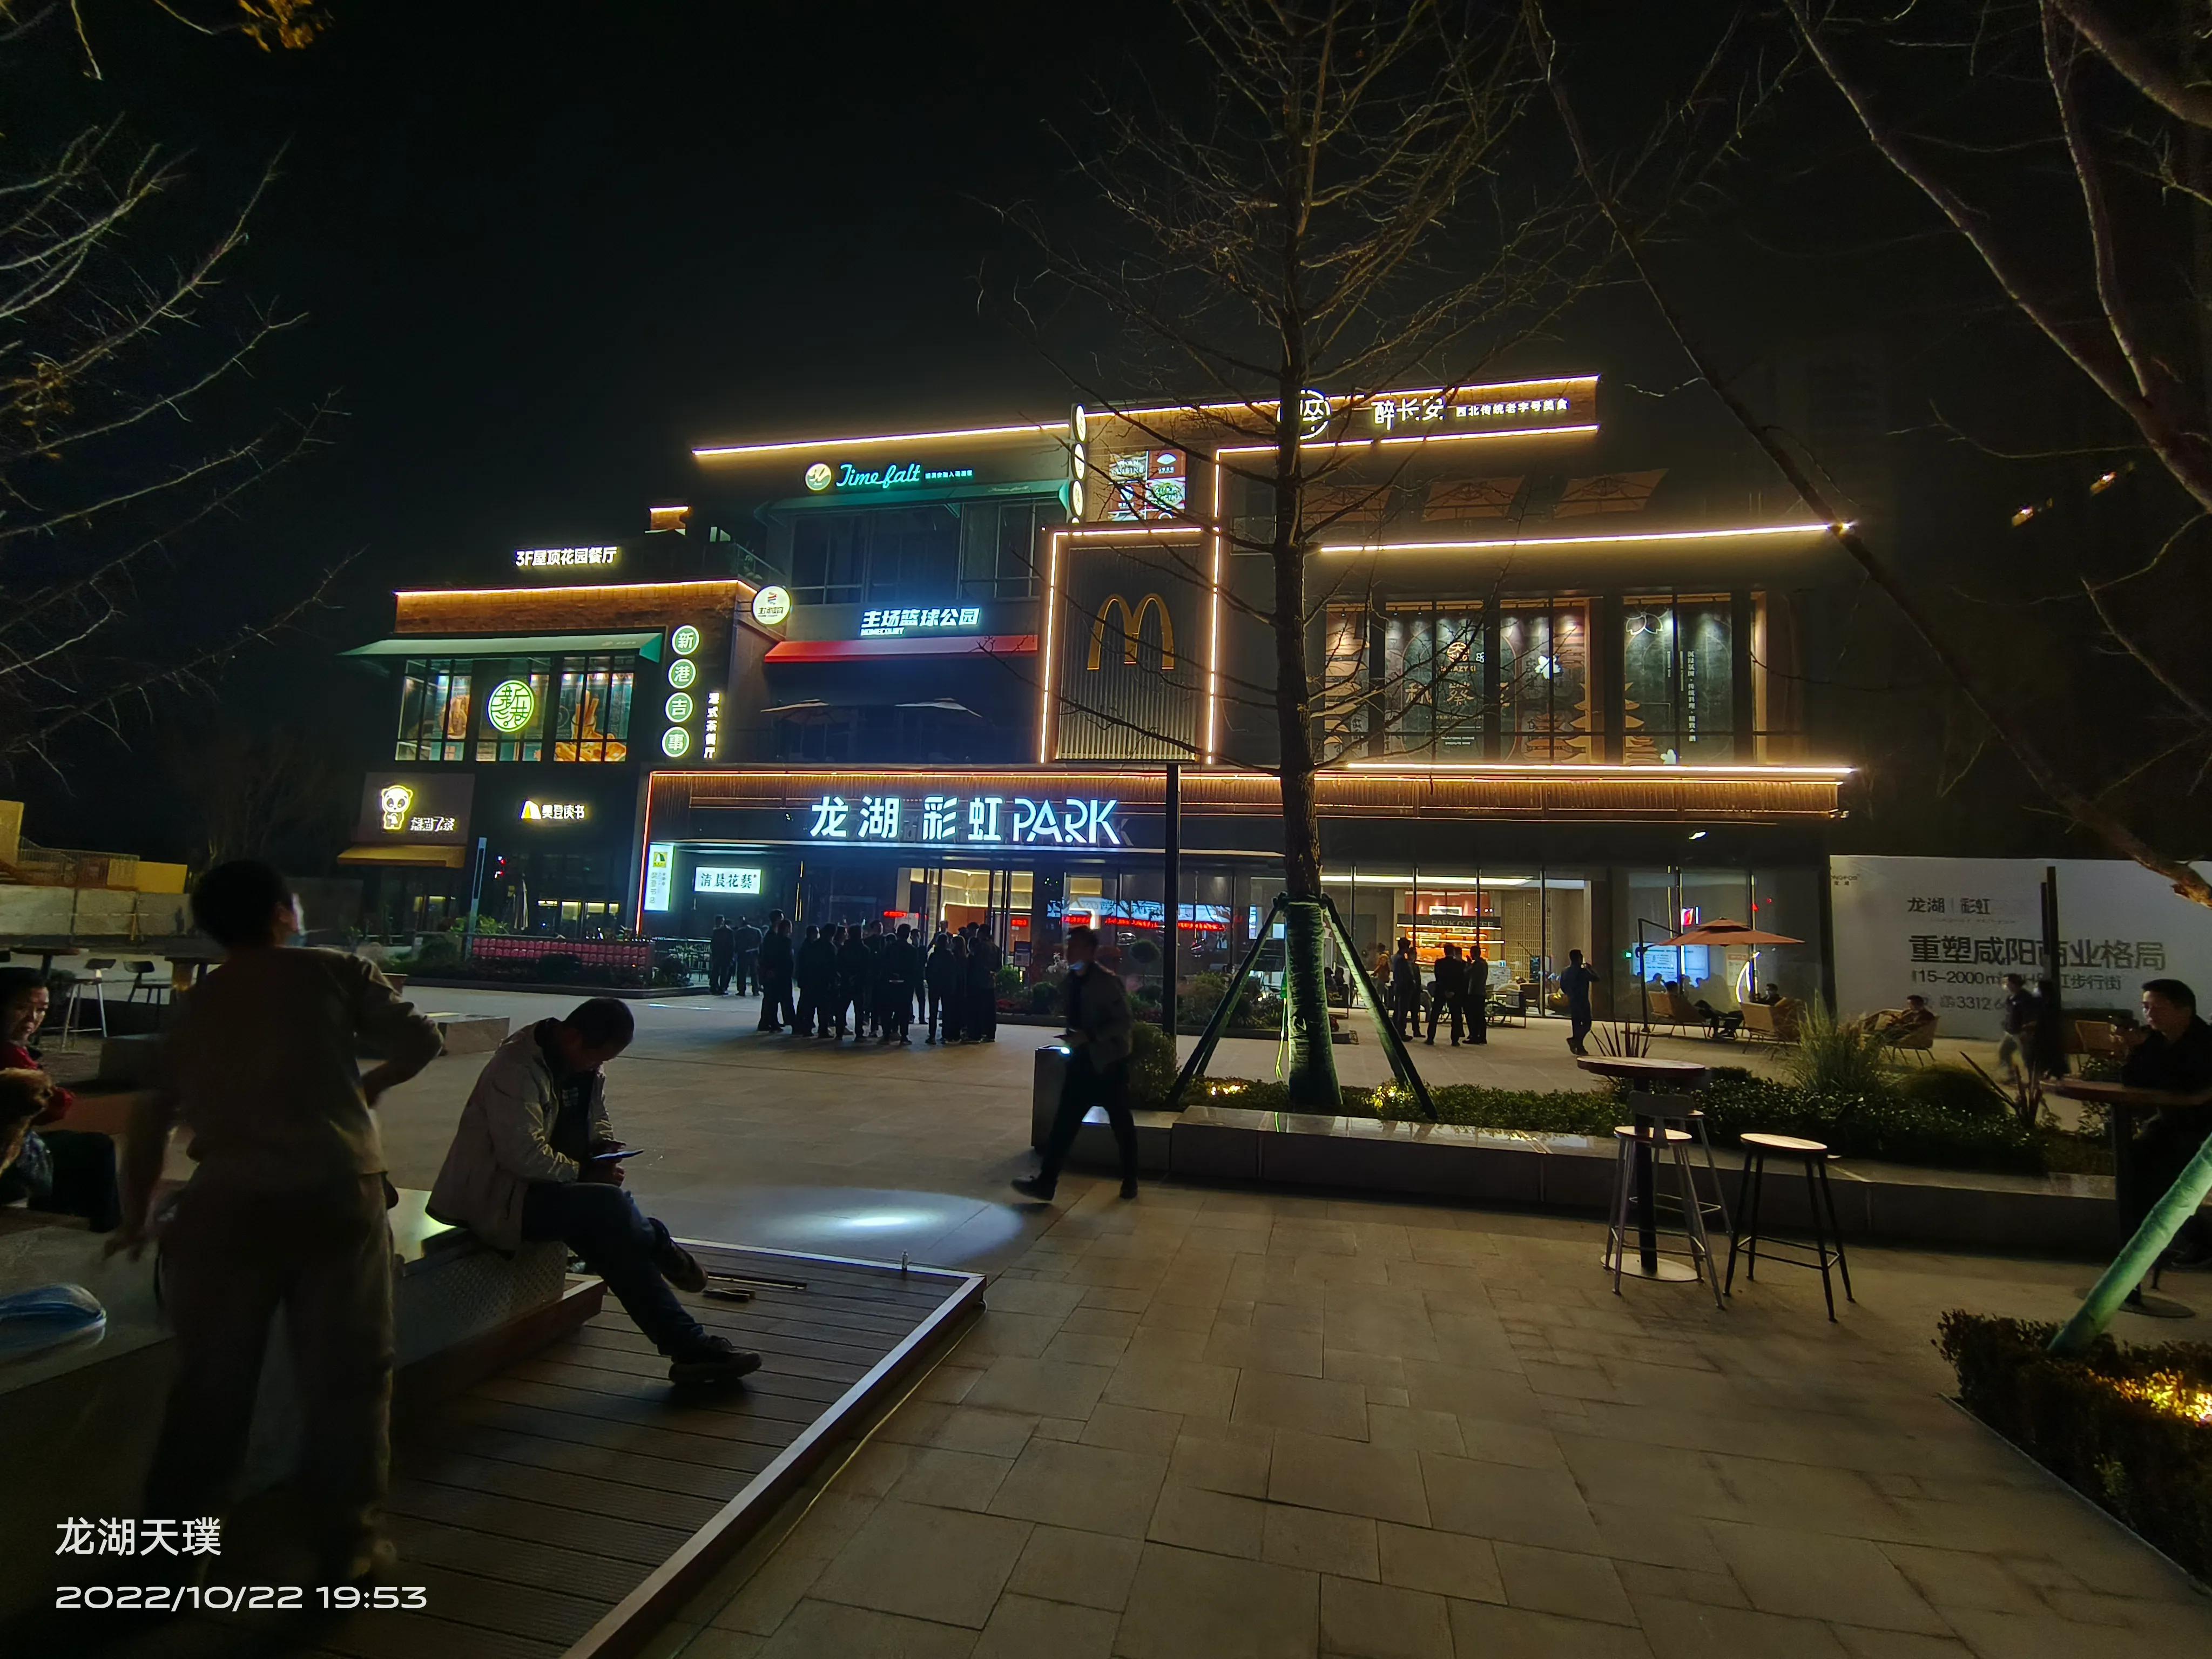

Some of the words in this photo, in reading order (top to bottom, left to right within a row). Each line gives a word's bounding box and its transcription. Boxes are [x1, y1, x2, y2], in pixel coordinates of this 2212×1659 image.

[1371, 396, 1445, 430] 醉长安
[515, 547, 617, 567] 3F屋顶花园餐厅
[861, 608, 980, 628] 主场篮球公园
[666, 630, 696, 753] 新港吉事
[1013, 798, 1122, 845] PARK
[1907, 897, 1945, 914] 龙湖
[1959, 897, 1992, 915] 彩虹
